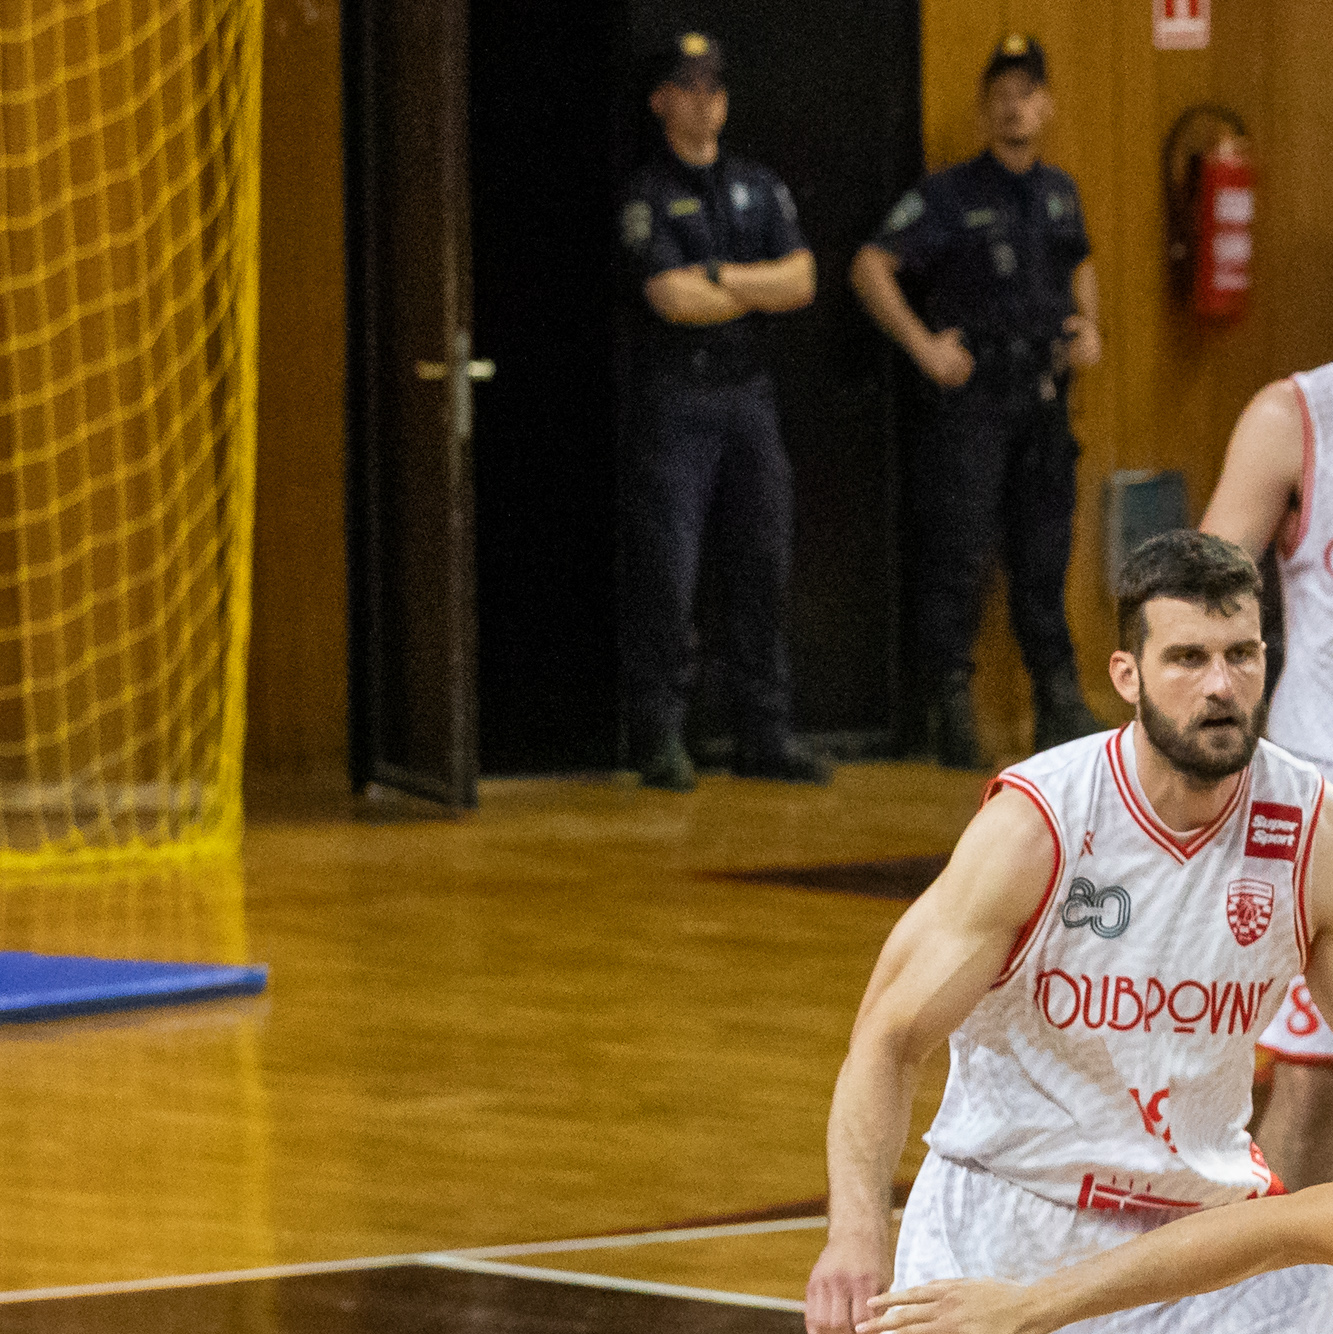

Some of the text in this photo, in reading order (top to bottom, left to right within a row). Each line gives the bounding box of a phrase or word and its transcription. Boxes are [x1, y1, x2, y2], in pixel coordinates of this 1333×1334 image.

[1251, 814, 1299, 831] Super
[1251, 830, 1296, 847] Sport
[1286, 985, 1319, 1037] 8
